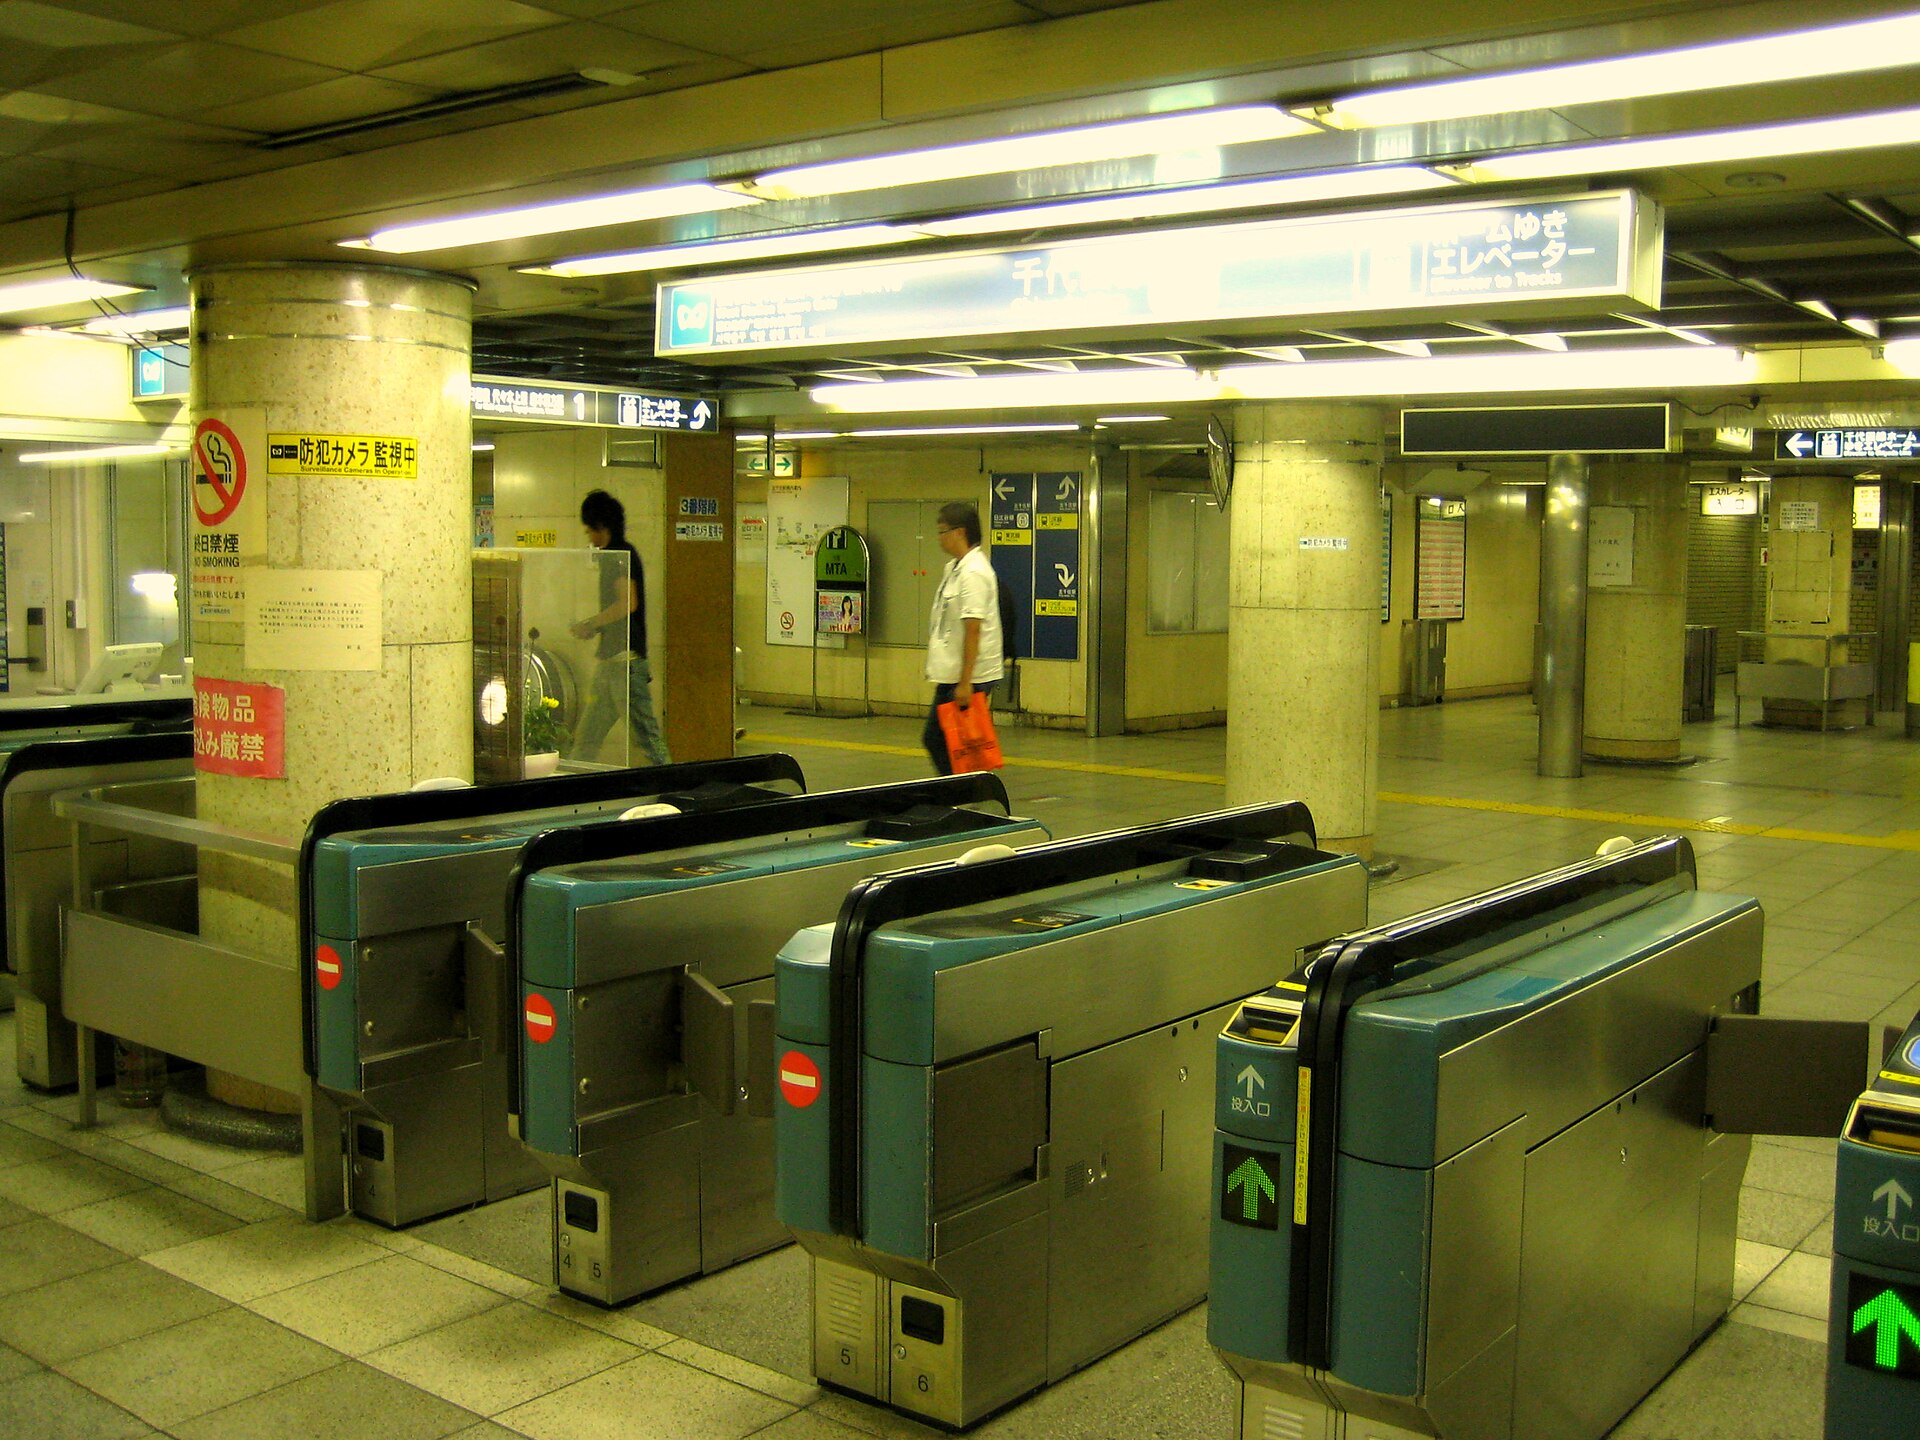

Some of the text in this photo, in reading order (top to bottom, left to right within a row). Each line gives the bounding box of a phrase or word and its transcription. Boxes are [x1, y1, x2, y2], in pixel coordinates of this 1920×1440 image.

[1431, 240, 1596, 275] エレベーター
[573, 392, 585, 421] 1
[299, 437, 415, 469] 防犯カメラ 監視中
[194, 533, 240, 553] 終日禁煙
[202, 556, 240, 568] SMOKING
[825, 562, 848, 576] MTA
[194, 727, 265, 762] 込み厳禁
[1230, 1095, 1271, 1117] 投入口
[368, 1185, 376, 1199] 4
[1863, 1215, 1920, 1242] 投入口
[563, 1254, 602, 1279] 4 5
[840, 1348, 929, 1393] 5 6
